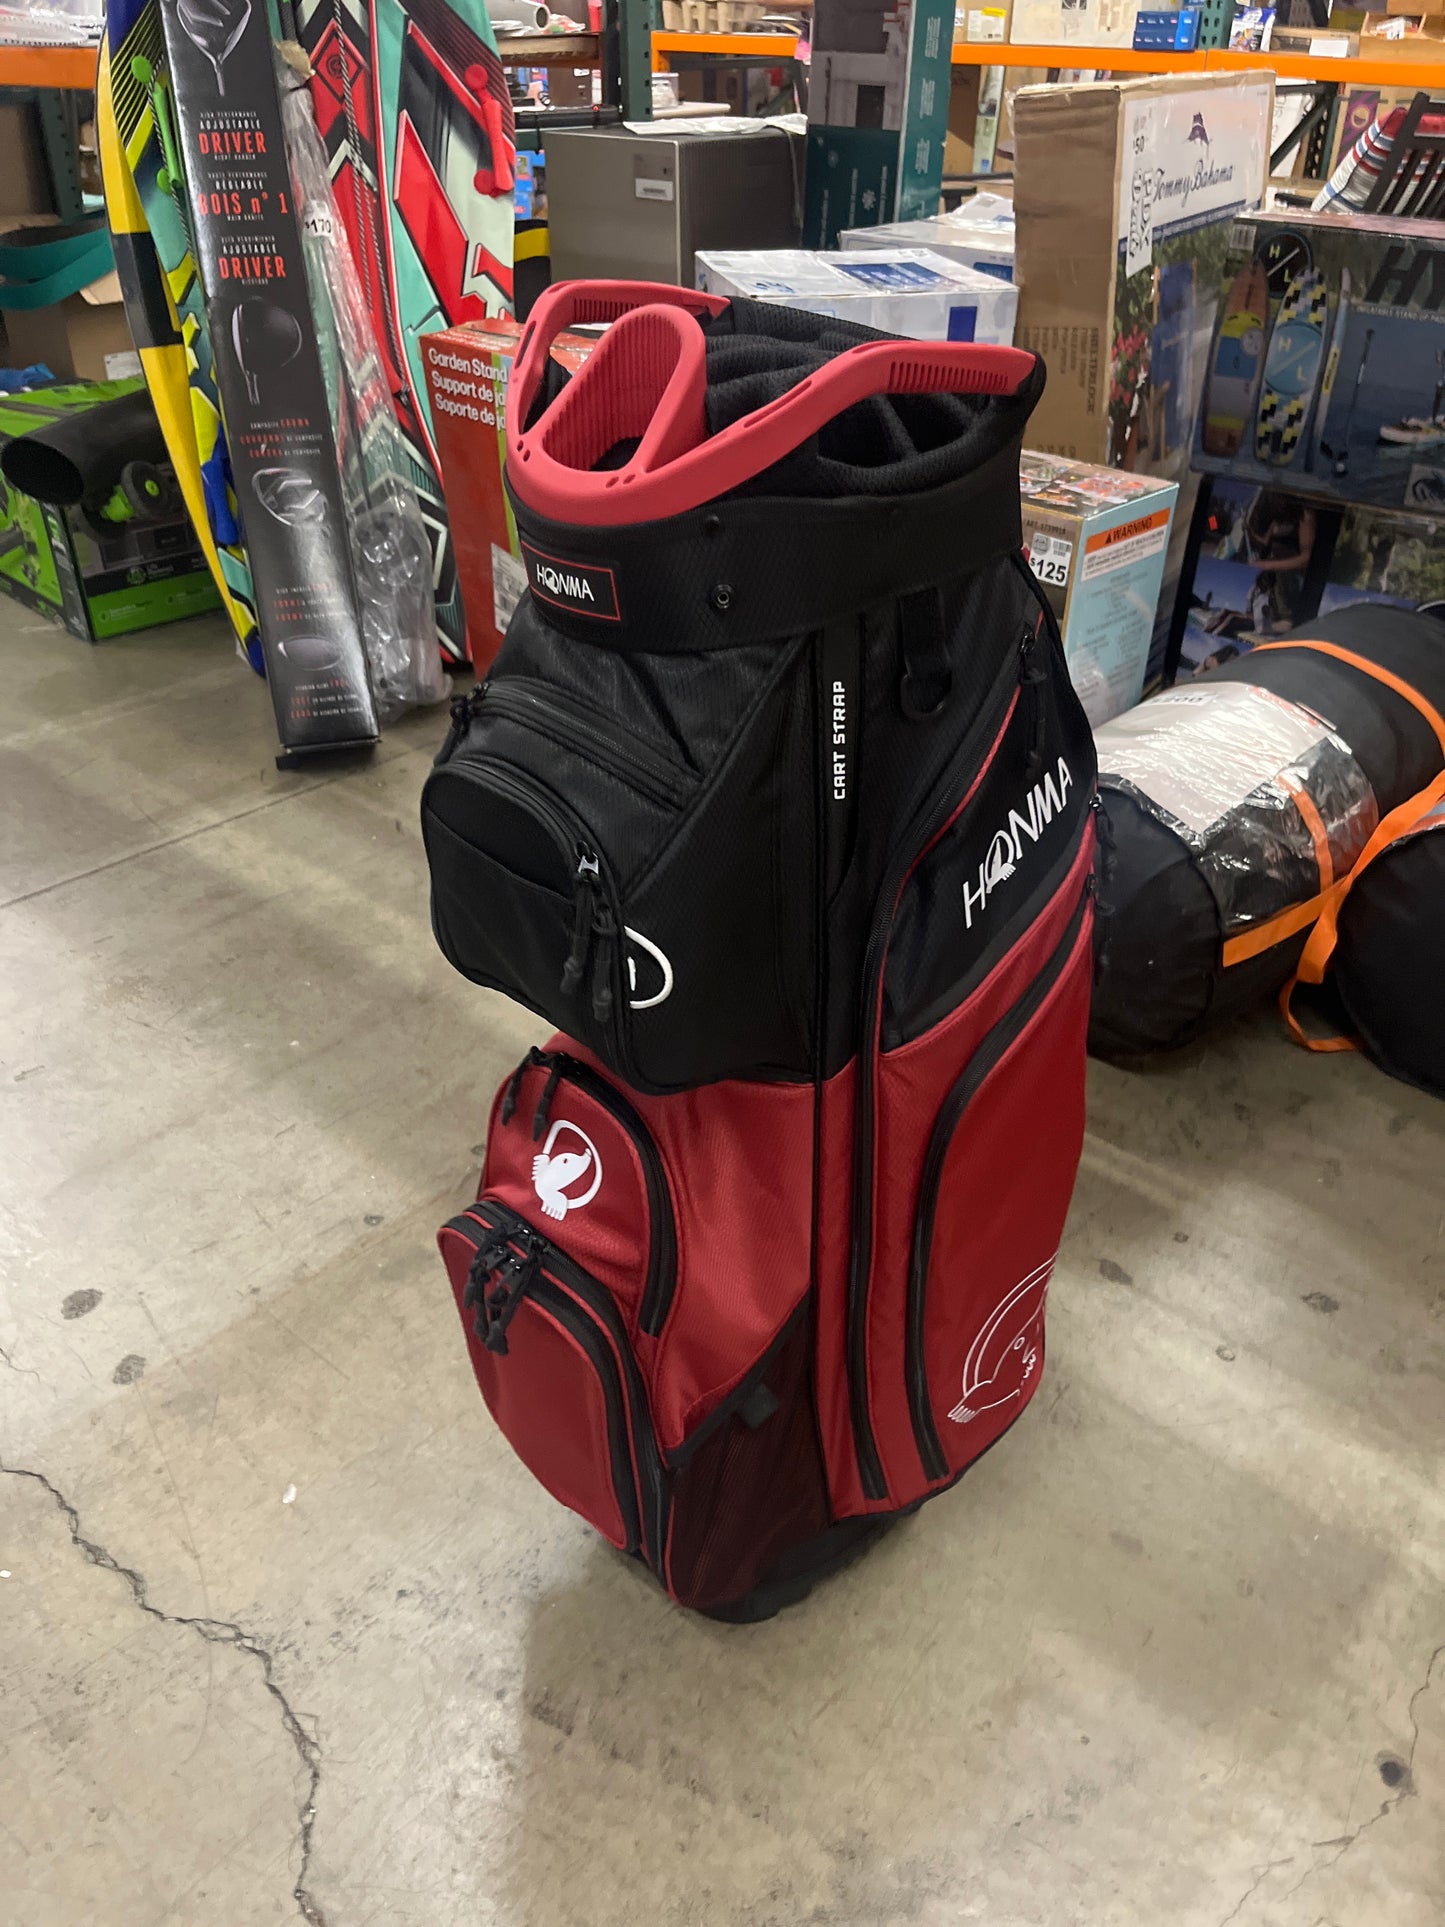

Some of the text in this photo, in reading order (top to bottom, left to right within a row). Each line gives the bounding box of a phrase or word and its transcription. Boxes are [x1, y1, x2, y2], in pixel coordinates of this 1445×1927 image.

[200, 119, 261, 130] ADJUSTABLE
[198, 131, 267, 155] DRIVER
[1153, 159, 1234, 208] Tommy Bahama
[197, 192, 242, 216] BOIS
[279, 192, 288, 214] 1
[223, 243, 277, 255] AJUSTABLE
[218, 255, 286, 279] DRIVER
[428, 347, 508, 383] Garden Stand
[431, 370, 477, 398] Support
[478, 384, 494, 403] de
[435, 393, 479, 421] Soporte
[480, 407, 496, 426] de
[1112, 517, 1152, 541] WARNING
[536, 563, 595, 602] HONMA
[1030, 557, 1067, 583] $125
[833, 681, 846, 800] CART STRAP
[962, 756, 1073, 929] HONMA
